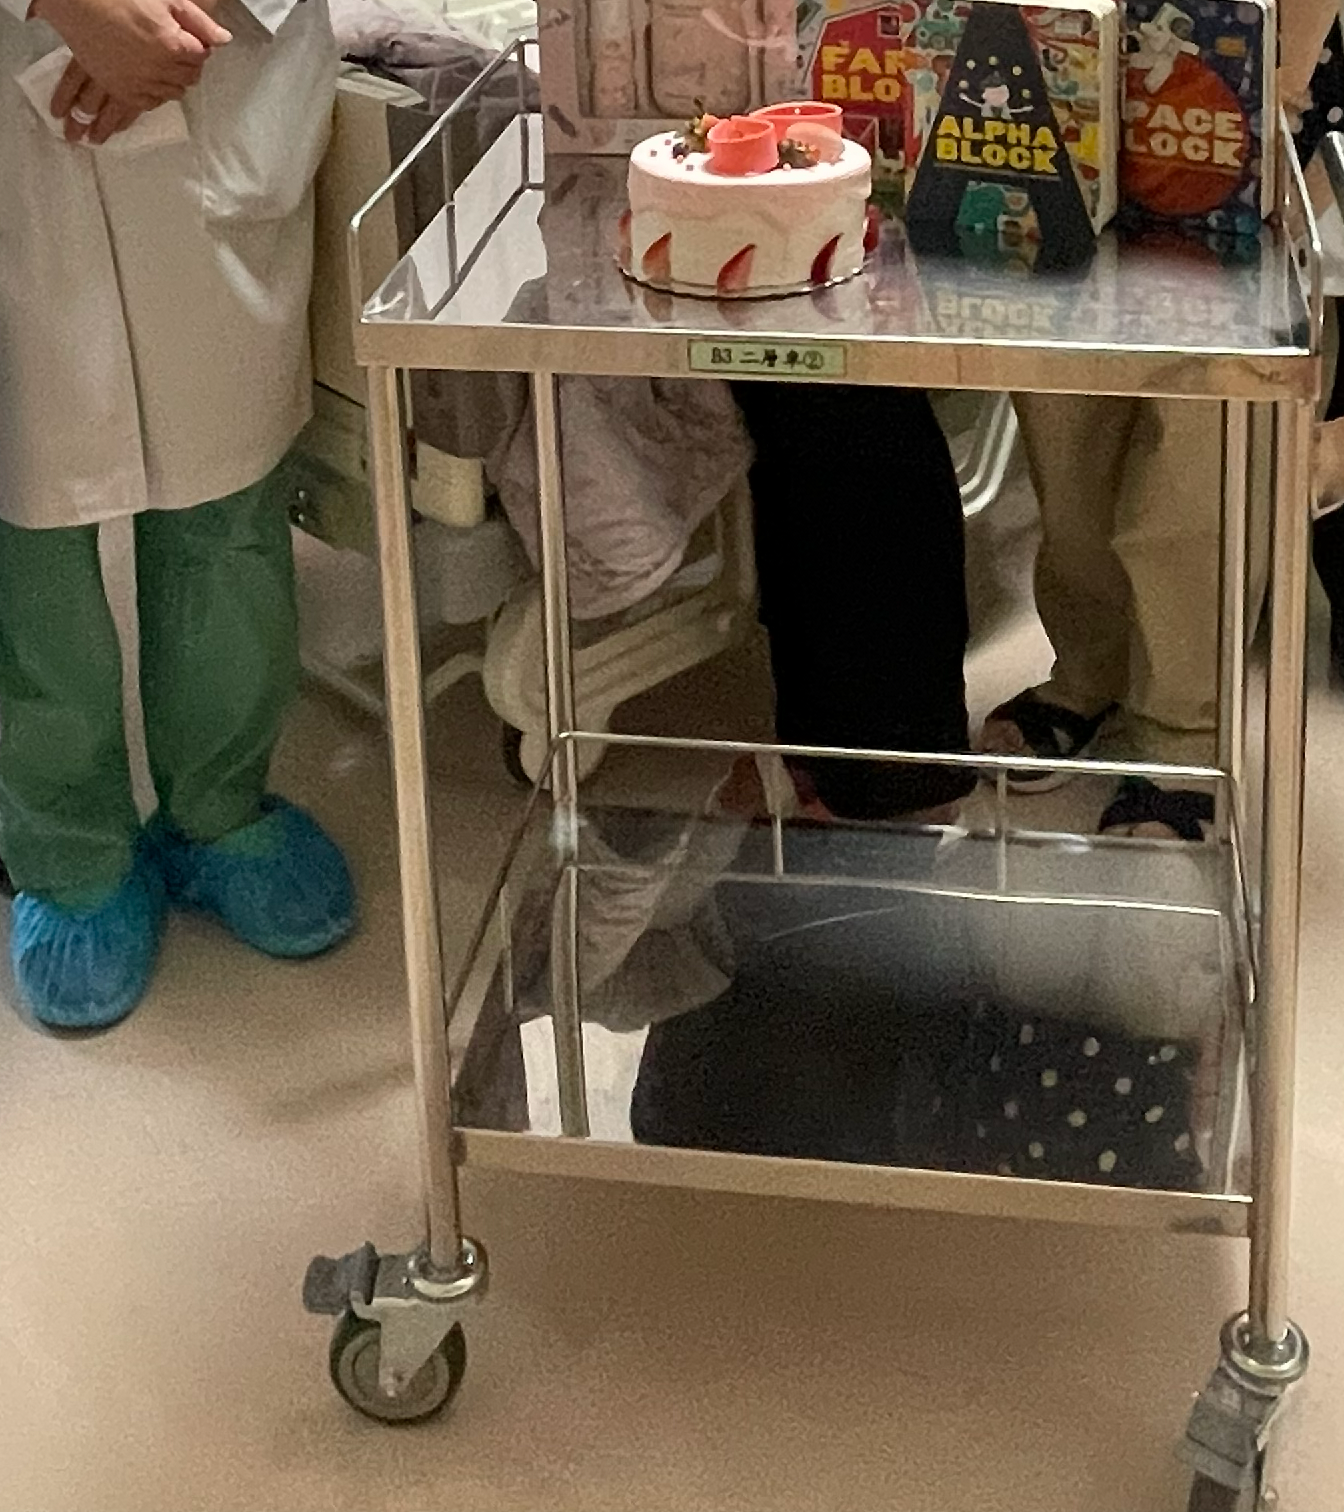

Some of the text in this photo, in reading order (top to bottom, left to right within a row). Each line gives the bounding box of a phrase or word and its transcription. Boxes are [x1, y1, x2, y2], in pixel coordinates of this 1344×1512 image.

[821, 43, 906, 74] FAR
[821, 74, 902, 103] BLO
[935, 114, 1059, 149] ALPHA
[1123, 100, 1244, 142] PACE
[935, 137, 1059, 174] BLOCK
[1124, 128, 1243, 168] LOCK
